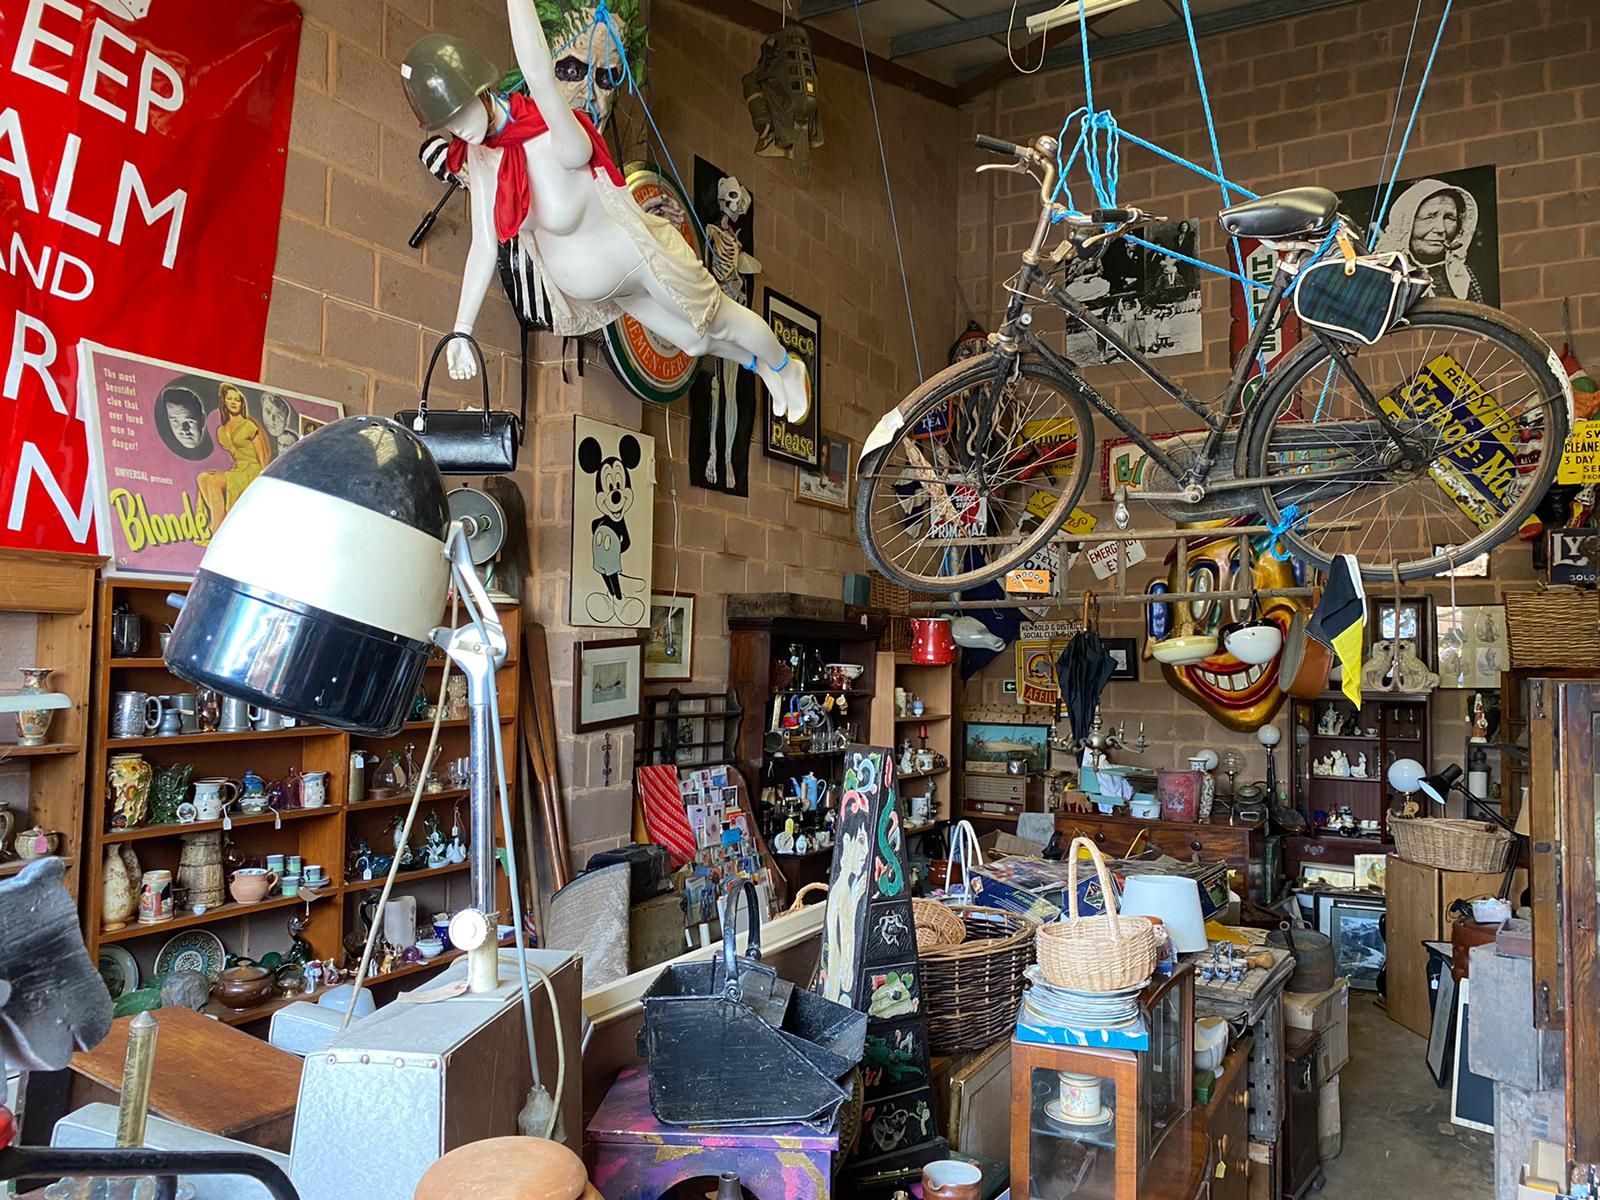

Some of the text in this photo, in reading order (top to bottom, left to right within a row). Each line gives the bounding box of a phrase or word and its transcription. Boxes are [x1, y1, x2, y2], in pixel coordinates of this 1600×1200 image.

[11, 0, 184, 134] EEP
[0, 106, 188, 270] ALM
[0, 231, 95, 301] ND
[773, 318, 815, 355] Peace
[103, 368, 136, 384] The most
[105, 382, 136, 397] beautiful
[1443, 368, 1491, 410] READY
[107, 396, 139, 411] clue that
[108, 411, 144, 424] ever lured
[110, 425, 135, 437] men to
[112, 437, 139, 452] danger!
[771, 421, 814, 458] Please
[1564, 441, 1600, 453] CLEANE
[1564, 455, 1595, 465] 3 DAY
[115, 467, 174, 485] UNIVERSAL presents
[7, 440, 97, 544] N
[109, 487, 212, 552] Blonde
[1035, 552, 1059, 569] SELL
[1021, 624, 1049, 632] NEWBOLD
[1026, 688, 1057, 703] AFFILI
